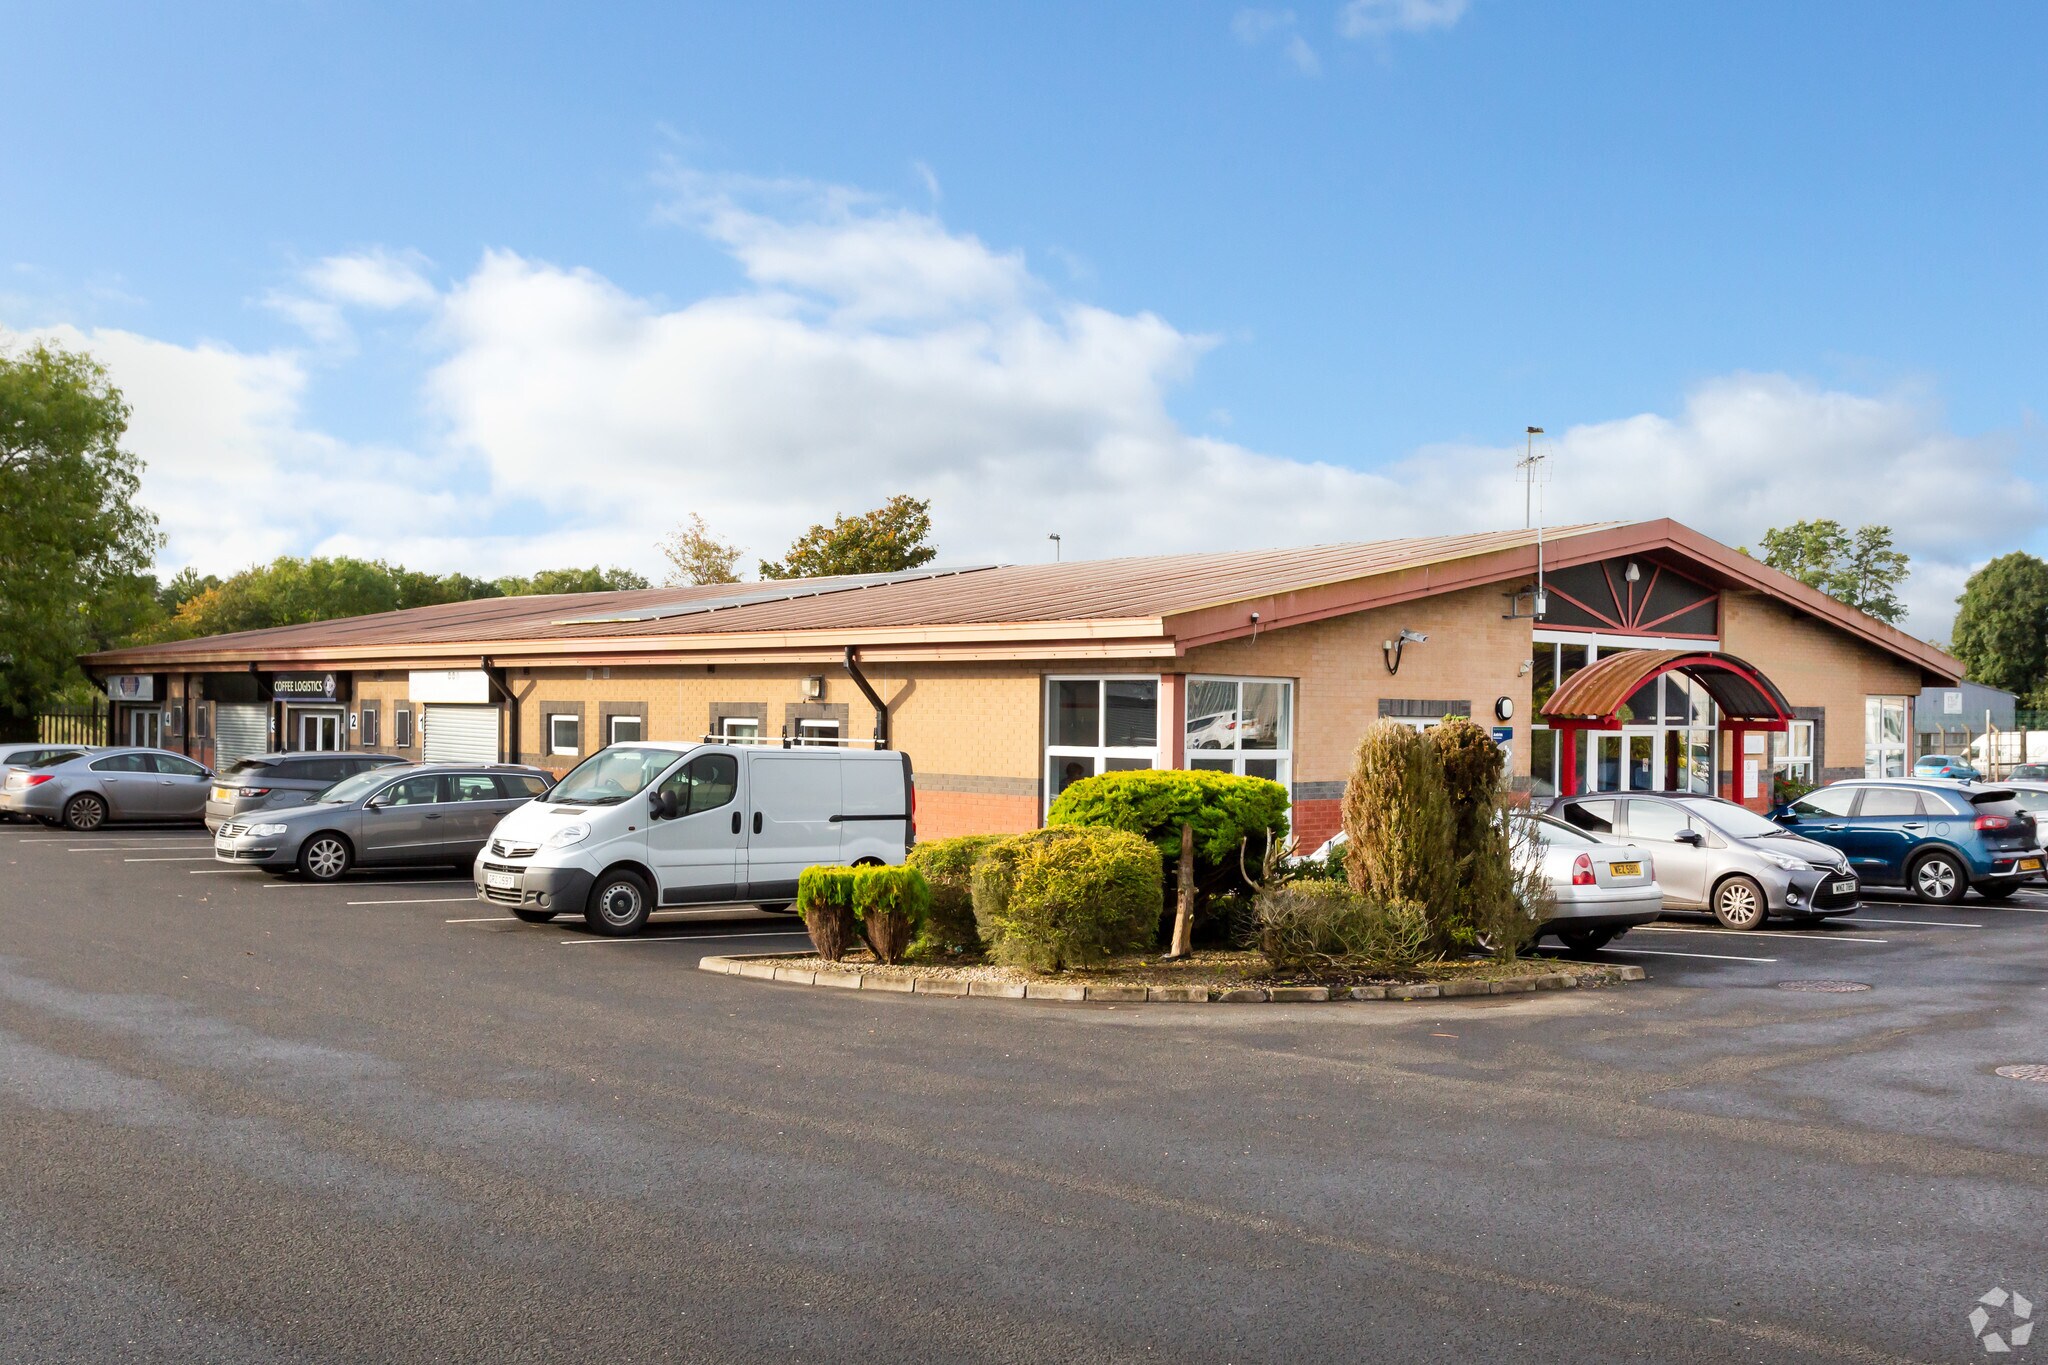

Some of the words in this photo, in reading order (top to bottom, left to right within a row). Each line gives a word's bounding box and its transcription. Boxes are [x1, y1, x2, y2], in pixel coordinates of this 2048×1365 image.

[274, 681, 294, 692] COFFEE
[294, 681, 322, 692] LOGISTICS
[351, 714, 356, 727] 2
